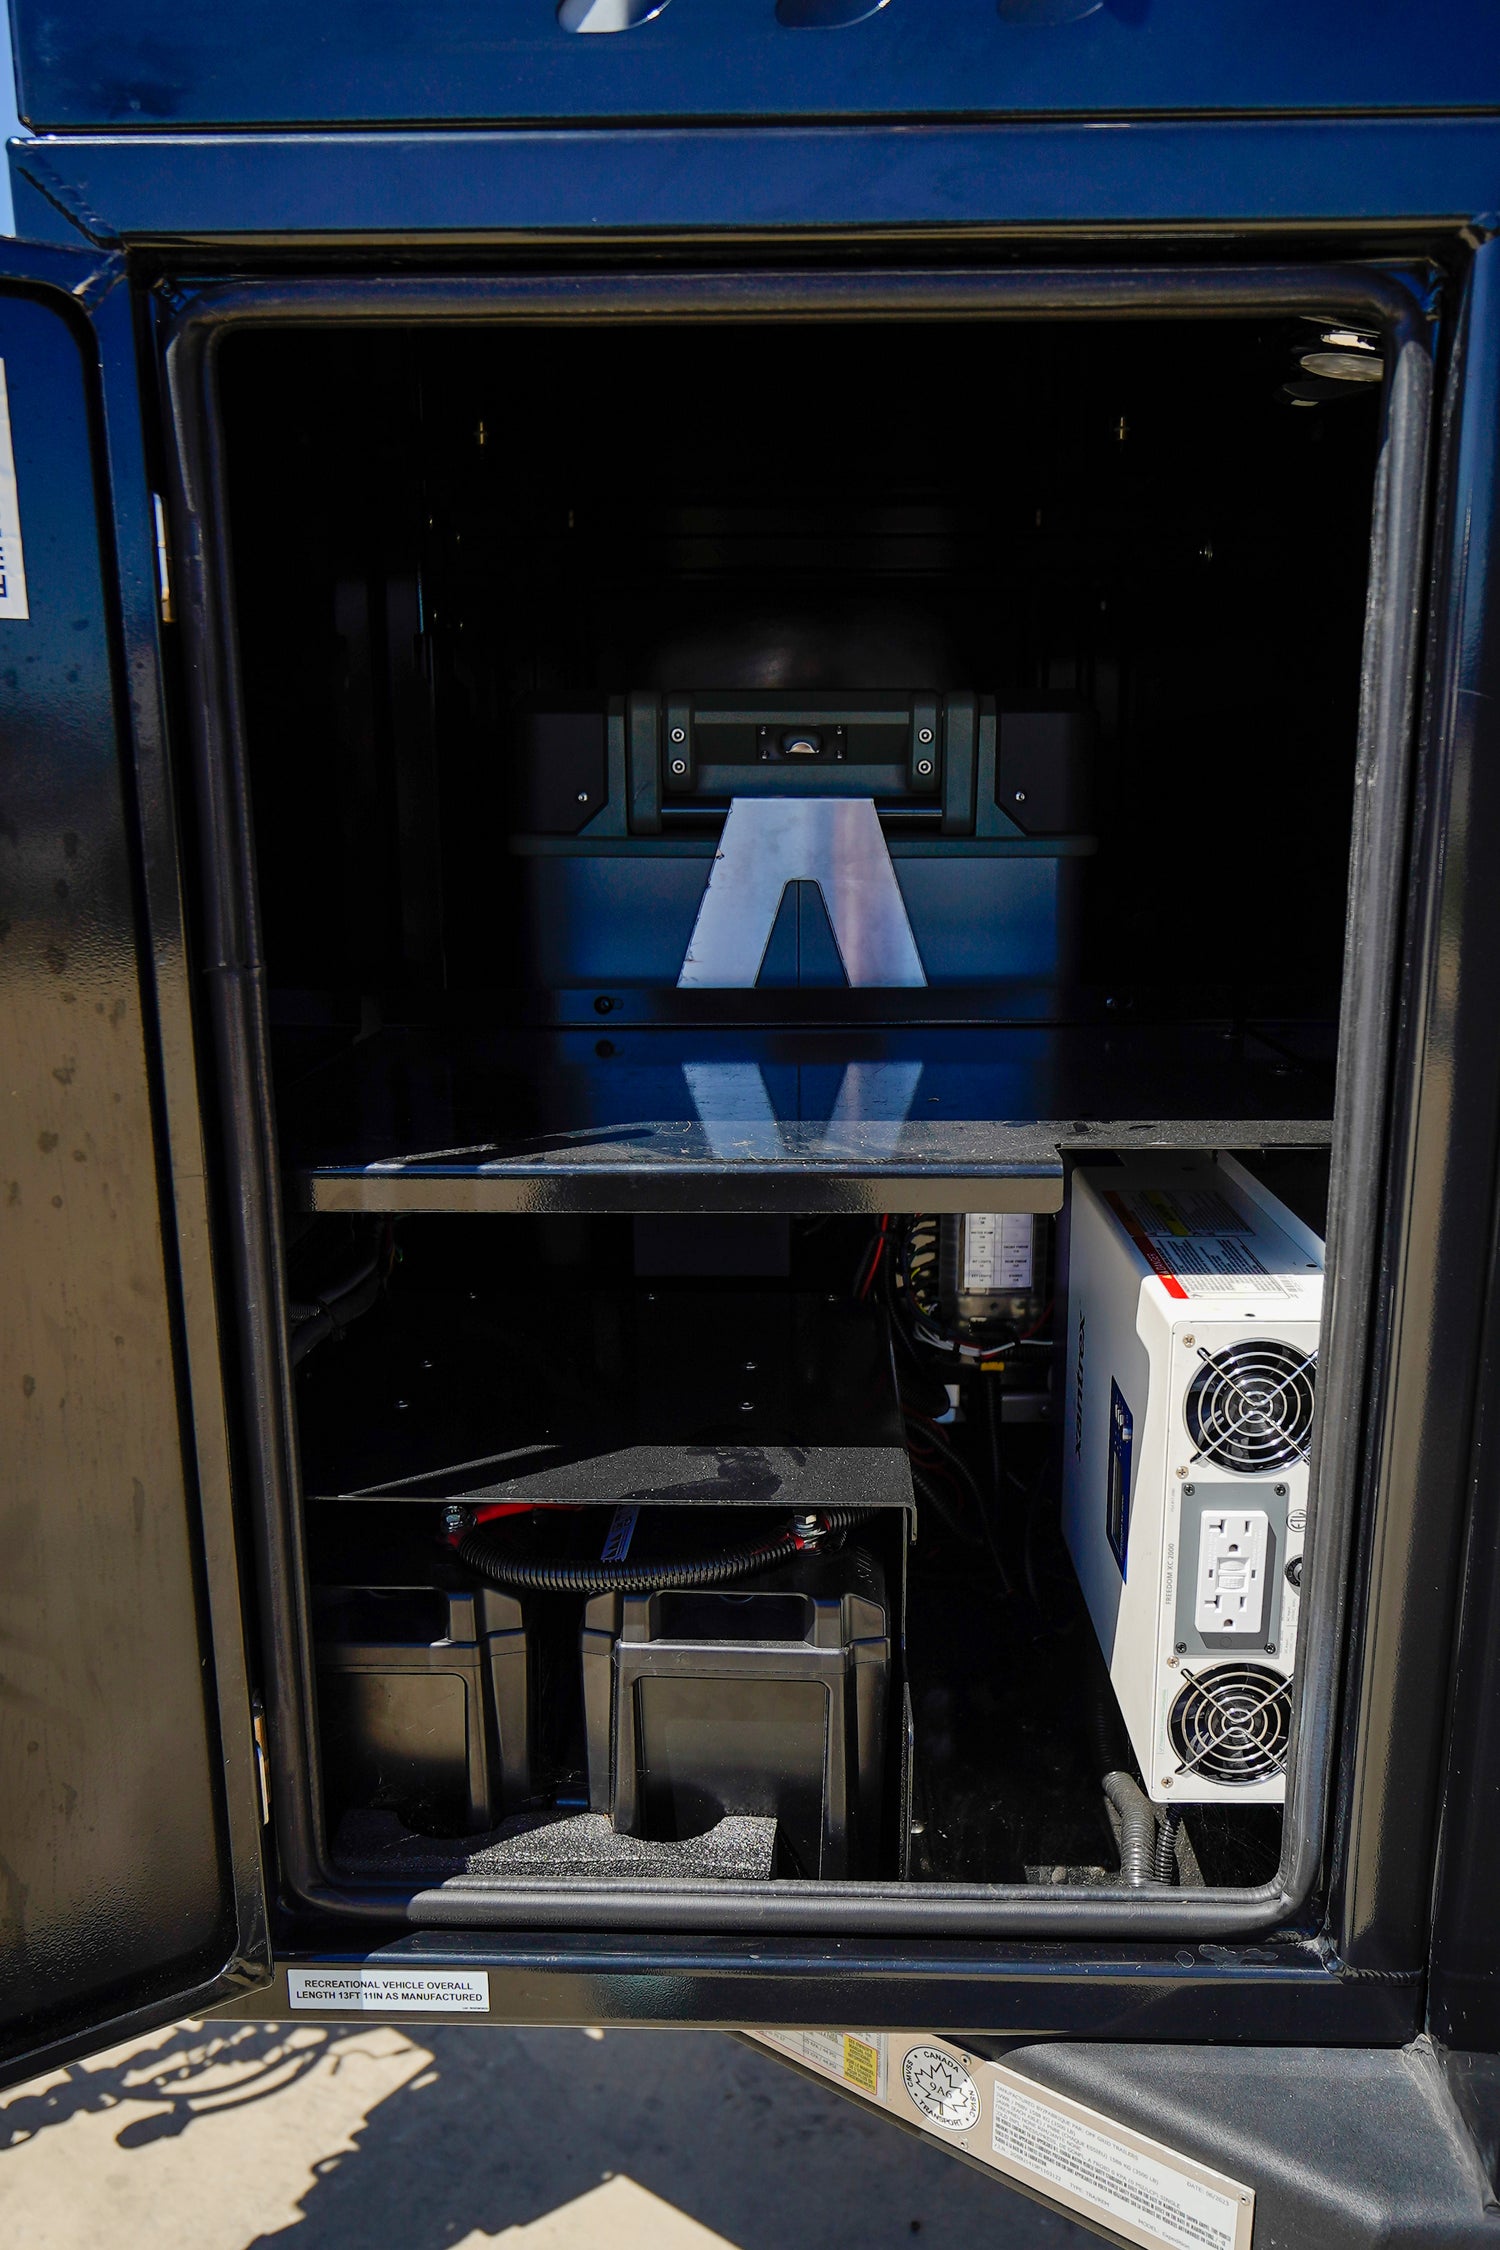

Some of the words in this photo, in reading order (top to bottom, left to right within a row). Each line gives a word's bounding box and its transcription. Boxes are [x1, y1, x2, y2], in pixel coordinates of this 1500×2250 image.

[1168, 1561, 1174, 1570] XC
[304, 1980, 380, 1989] RECREATIONAL
[382, 1982, 424, 1990] VEHICLE
[426, 1982, 472, 1990] OVERALL
[296, 1990, 336, 2000] LENGTH
[338, 1991, 360, 2000] 13FT
[364, 1992, 382, 2000] 11IN
[385, 1992, 399, 2000] AS
[402, 1993, 482, 2002] MANUFACTURED
[924, 2051, 959, 2072] CANADA
[906, 2060, 914, 2088] CMVSS
[930, 2082, 952, 2098] 9A6
[919, 2100, 963, 2126] TRANSPORT
